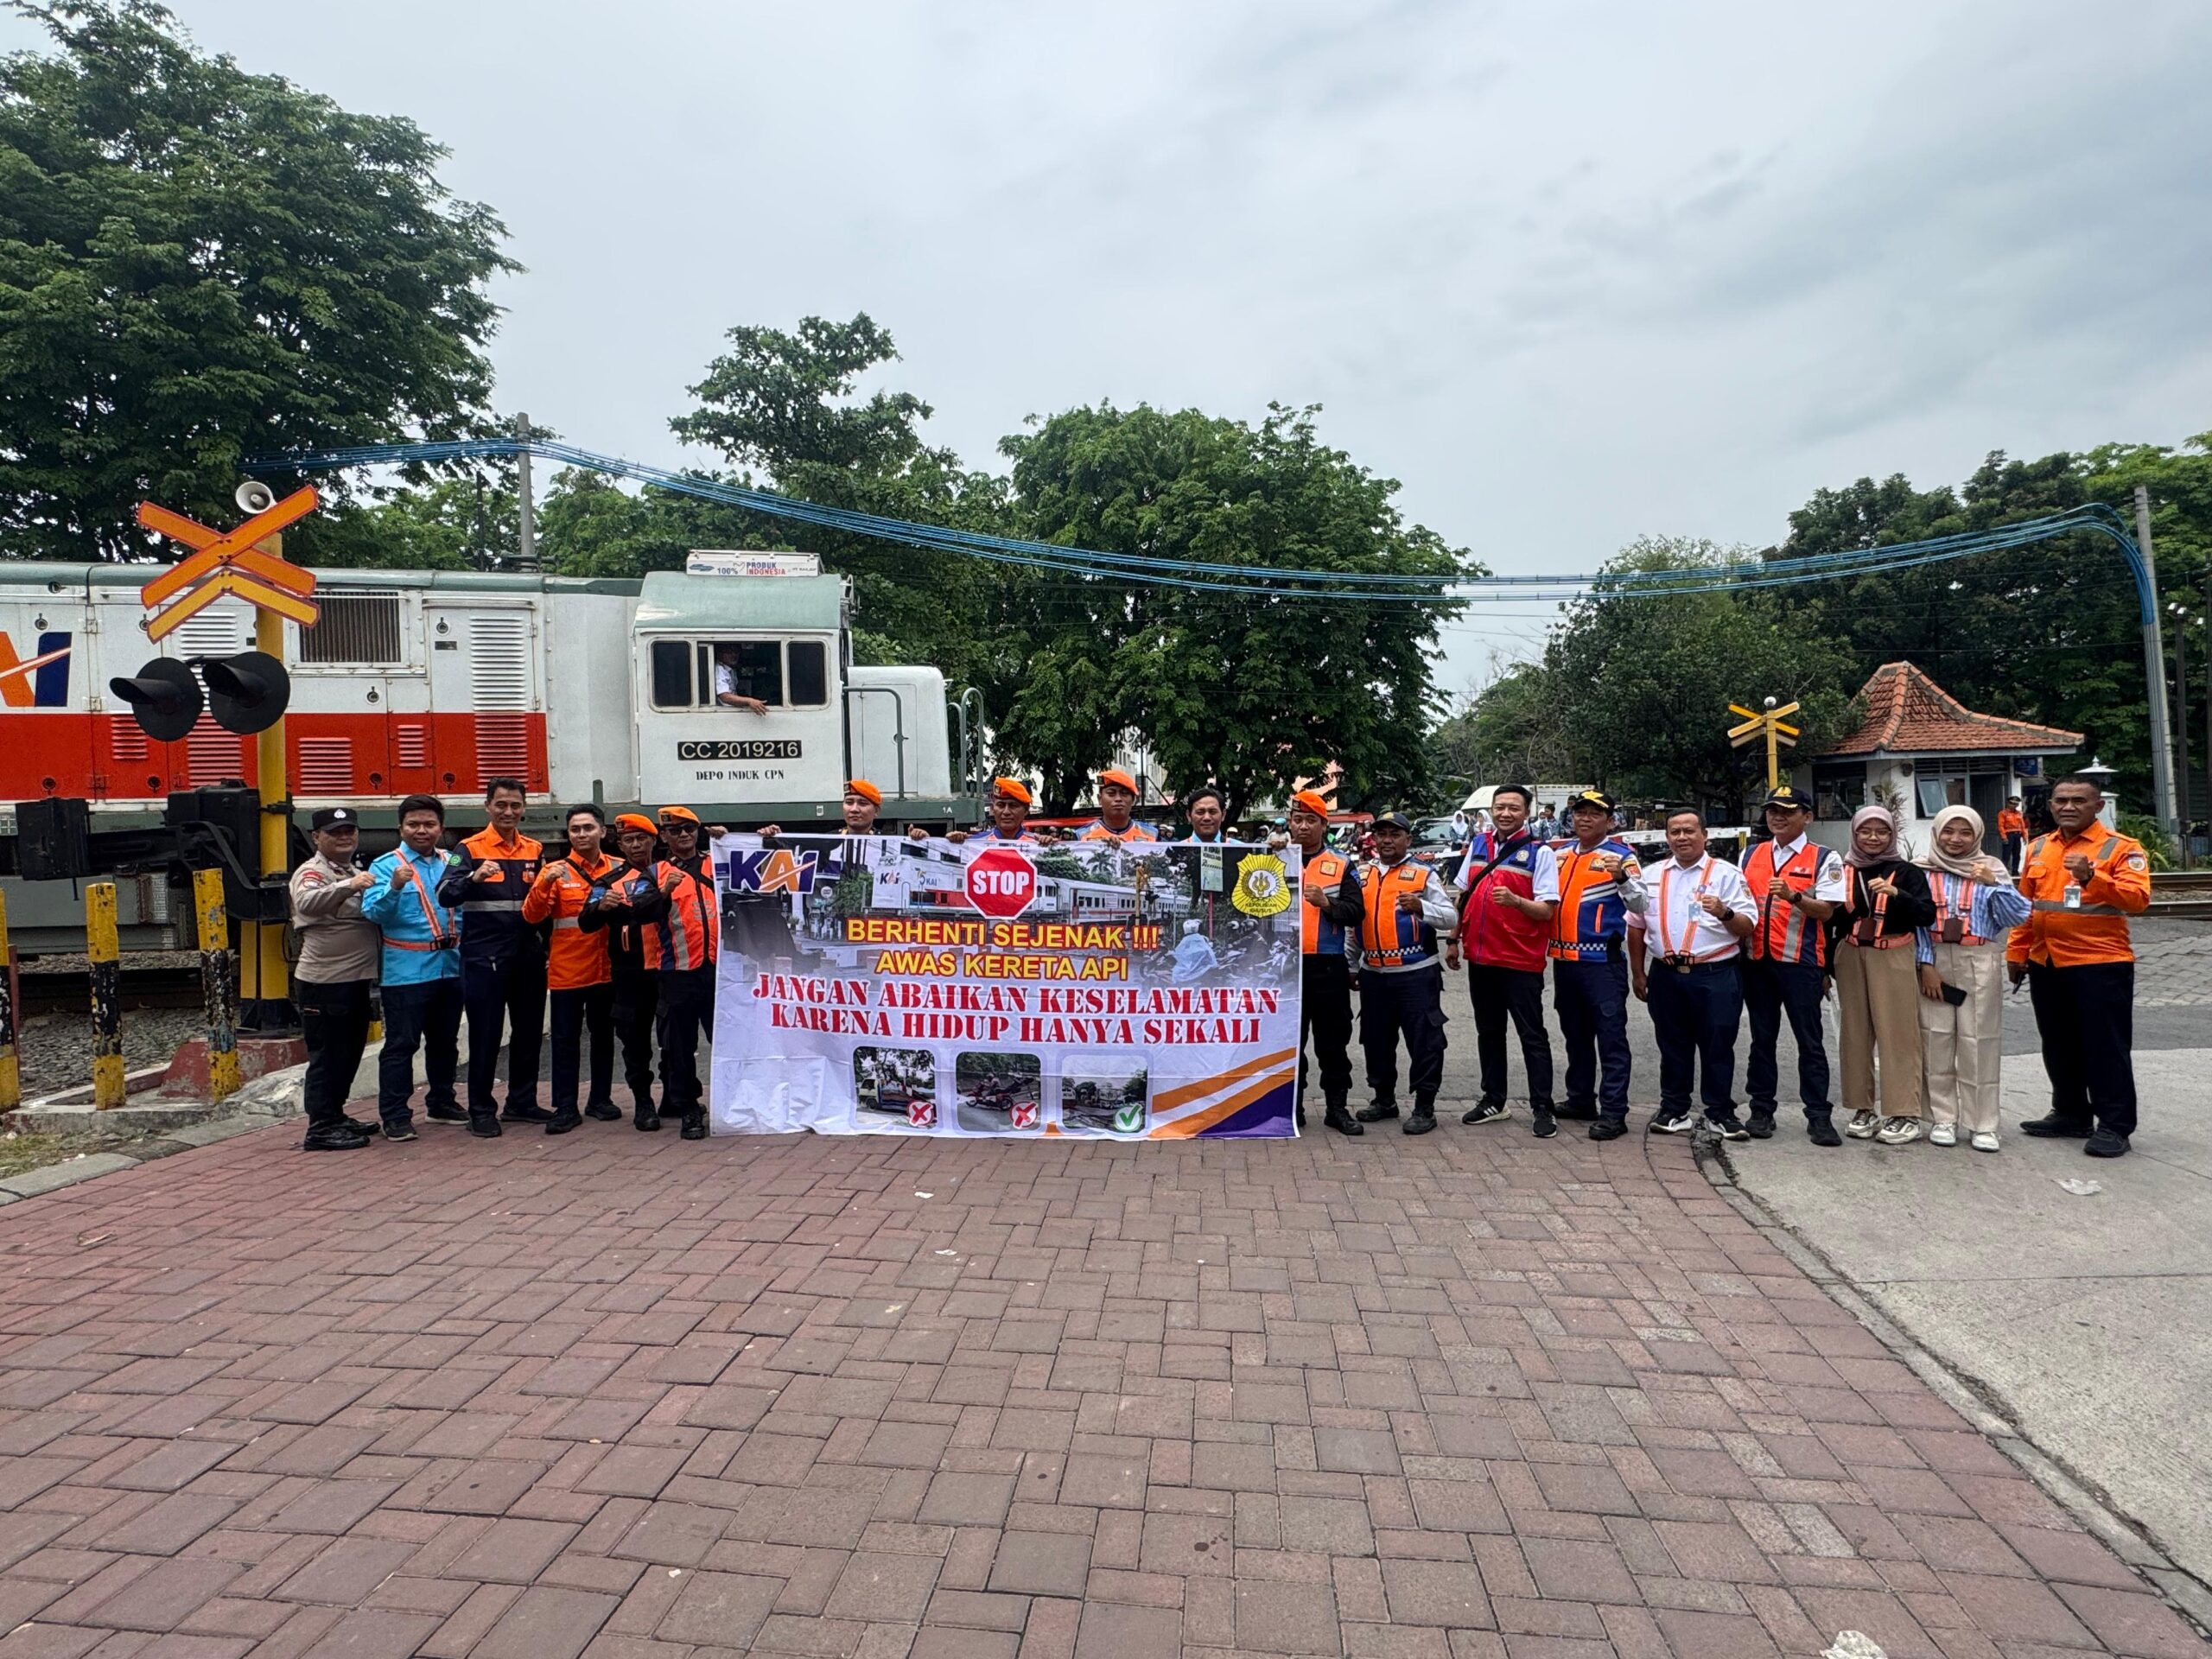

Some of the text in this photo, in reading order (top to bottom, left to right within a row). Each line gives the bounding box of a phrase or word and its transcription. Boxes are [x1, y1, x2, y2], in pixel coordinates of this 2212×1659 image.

[717, 567, 738, 575] 100%
[681, 741, 798, 759] CC 2019216
[696, 769, 785, 780] DEPO INDUK CPN
[729, 849, 819, 893] KAI
[972, 869, 1030, 896] STOP
[847, 918, 986, 945] BERHENTI
[993, 922, 1125, 950] SEJENAK
[874, 950, 1129, 982] AWAS KERETA API
[753, 974, 1280, 1014] JANGAN ABAIKAN KESELAMATAN
[771, 1002, 1262, 1044] KARENA HIDUP HANYA SEKALI
